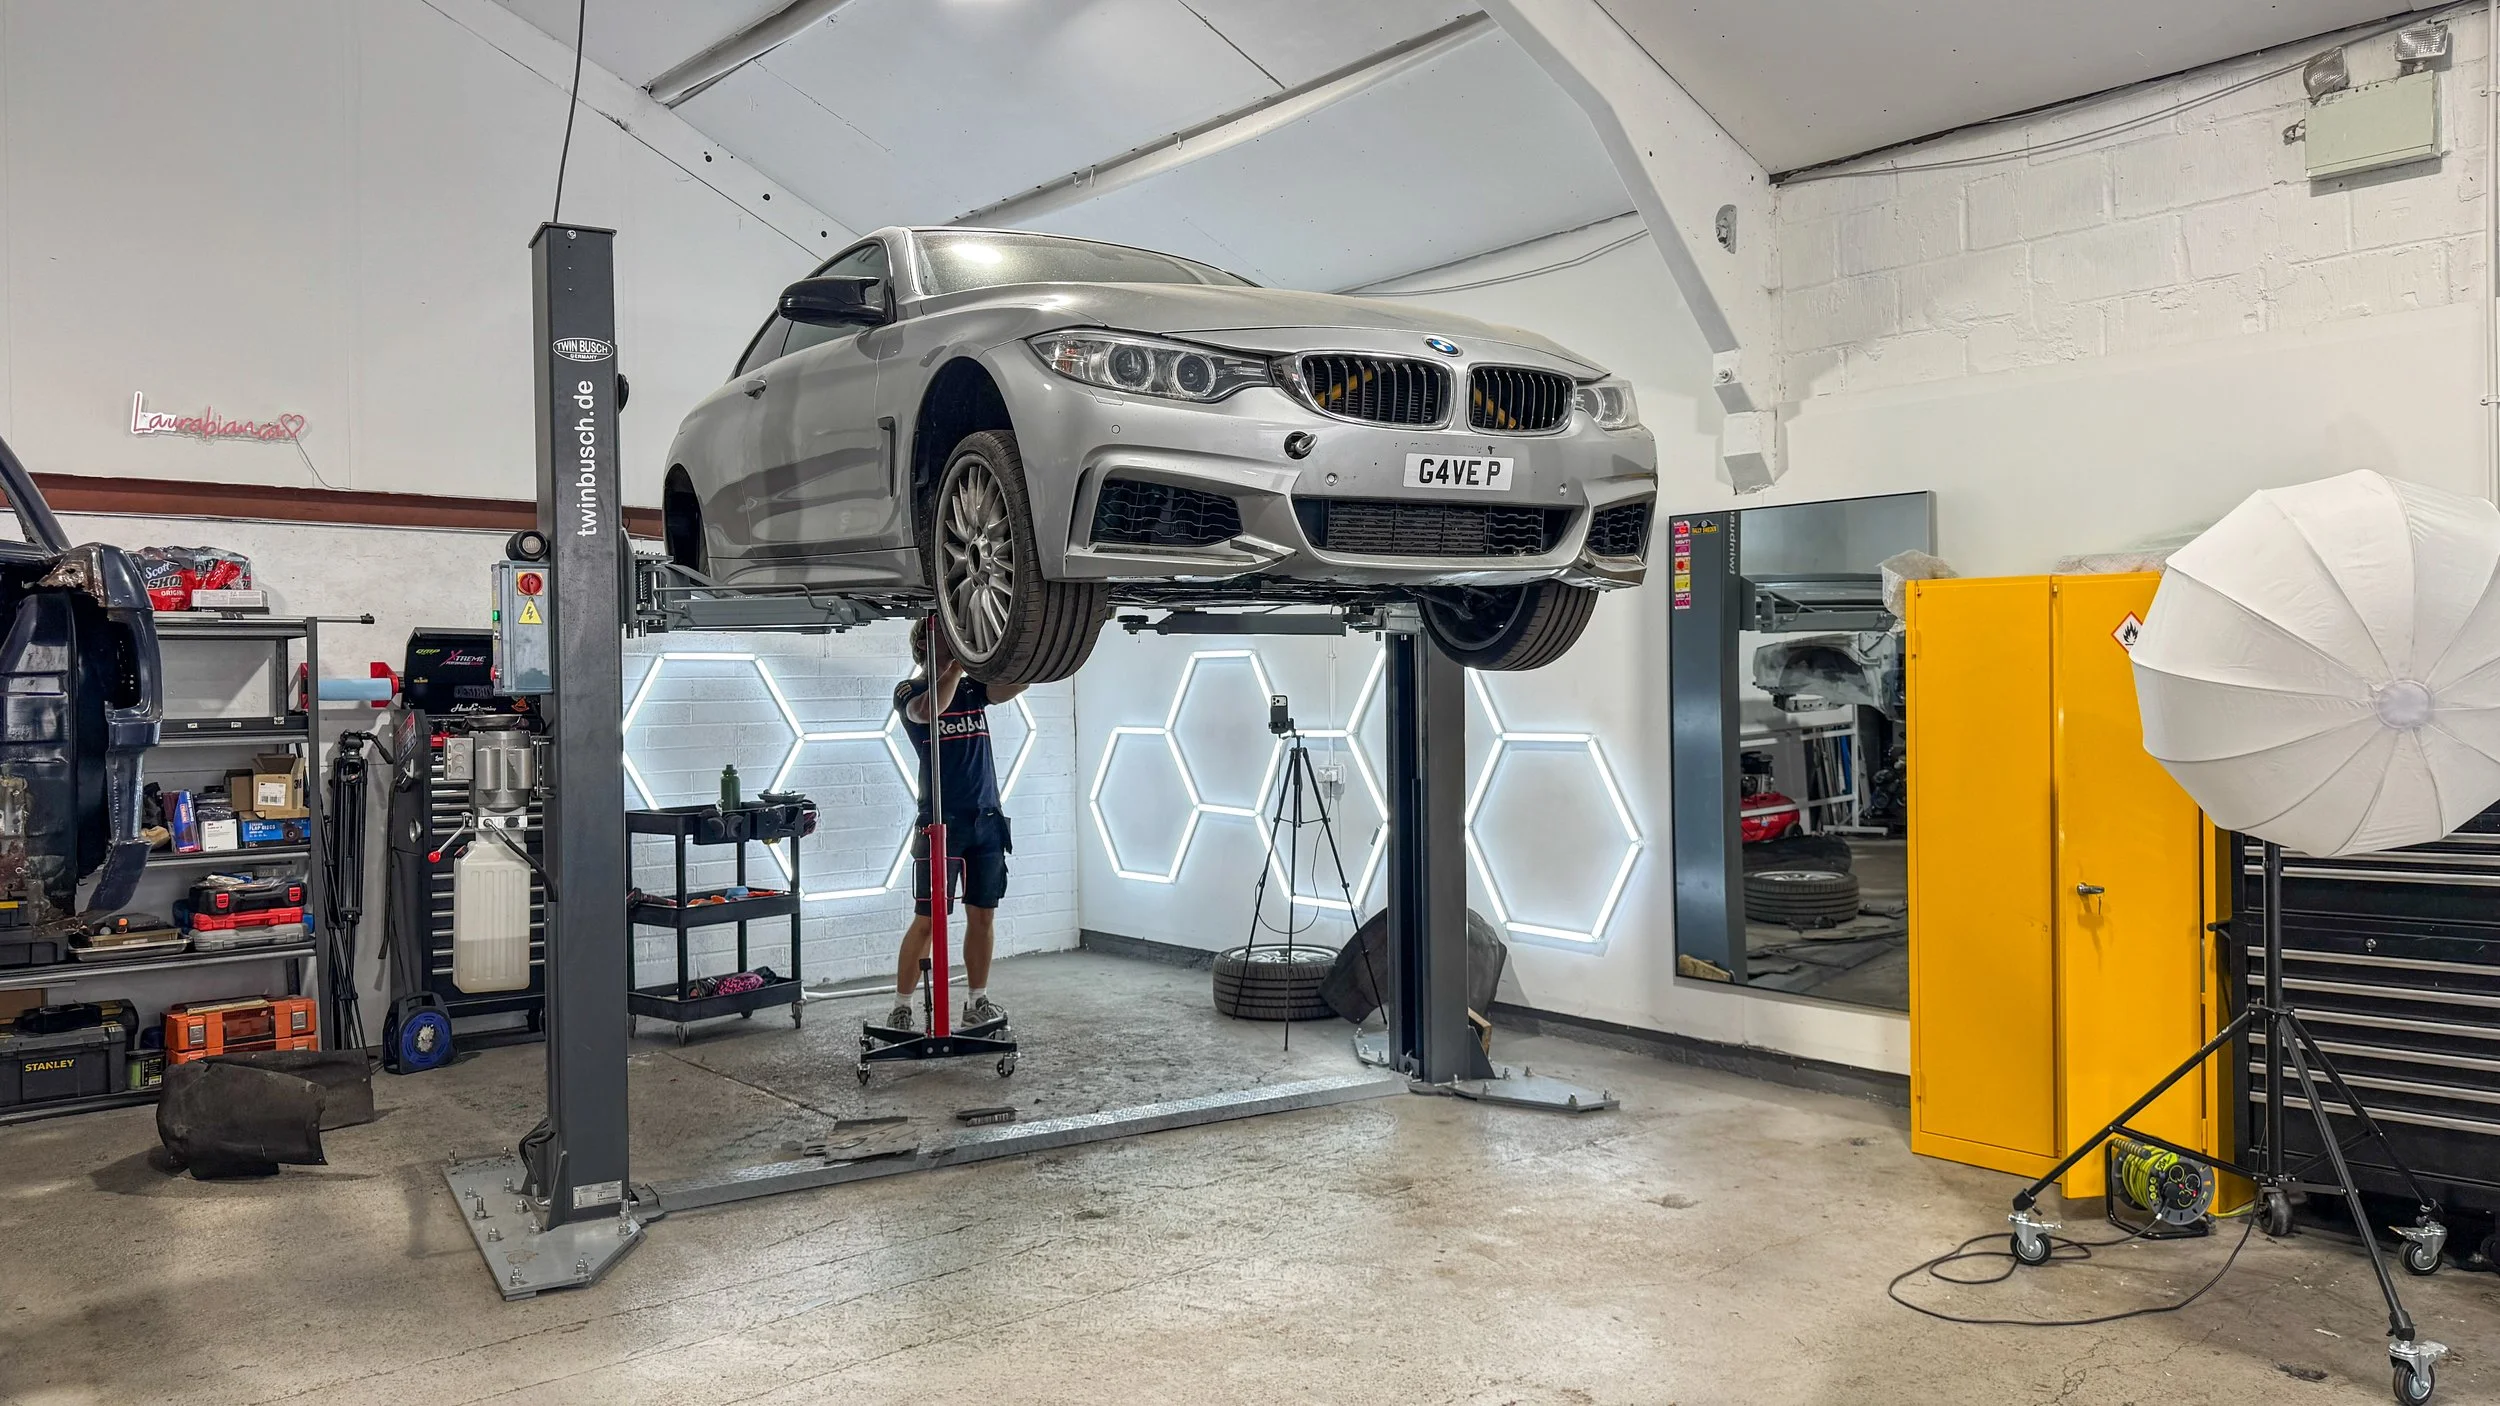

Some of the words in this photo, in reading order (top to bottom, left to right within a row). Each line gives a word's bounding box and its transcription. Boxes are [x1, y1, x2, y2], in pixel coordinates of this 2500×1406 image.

[556, 340, 578, 352] TWIN
[580, 340, 608, 354] BUSCH
[573, 380, 597, 537] twinbusch.de
[1419, 458, 1481, 485] G4VE
[1486, 461, 1501, 486] P
[145, 561, 172, 580] Scott
[25, 1059, 75, 1072] STANLEY
